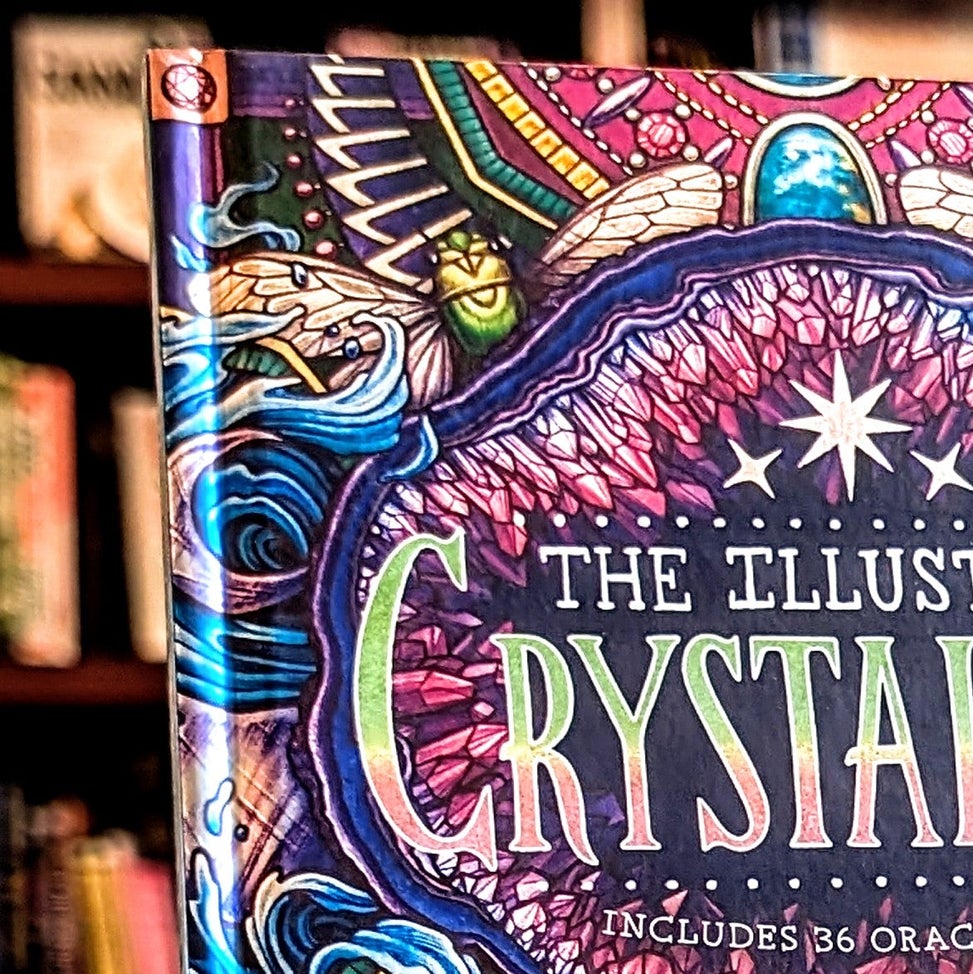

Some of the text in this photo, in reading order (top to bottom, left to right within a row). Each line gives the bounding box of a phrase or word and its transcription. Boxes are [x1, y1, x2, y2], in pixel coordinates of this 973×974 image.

[540, 546, 691, 611] THE
[602, 909, 798, 952] INCLUDES
[815, 925, 855, 954] 36
